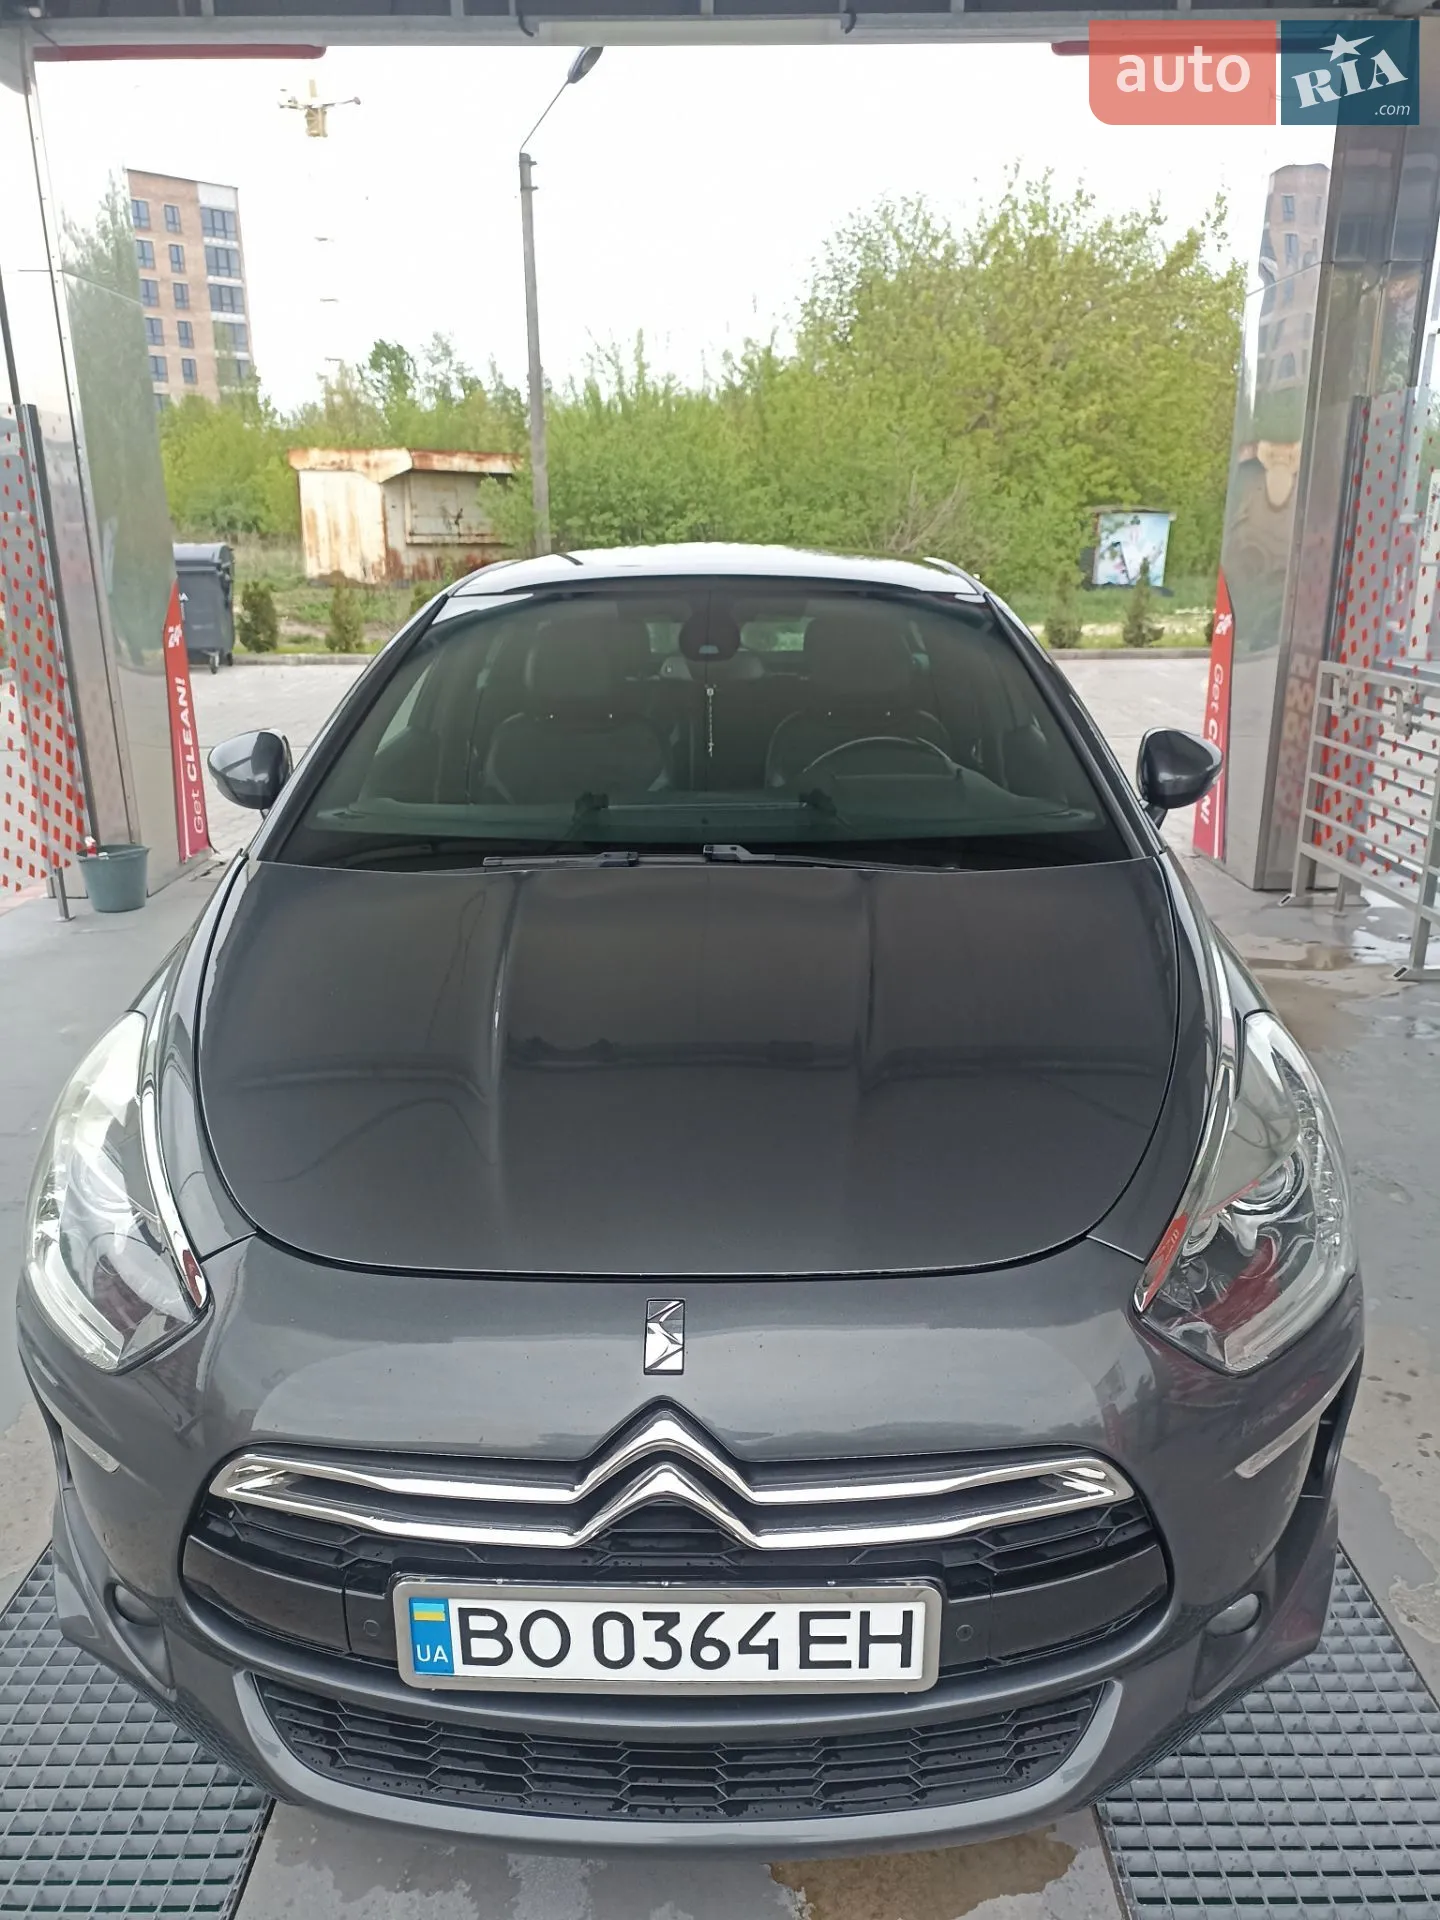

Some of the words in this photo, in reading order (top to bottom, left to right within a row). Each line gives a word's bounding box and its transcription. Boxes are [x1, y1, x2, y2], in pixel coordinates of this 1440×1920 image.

[175, 677, 197, 782] CLEAN!
[416, 1644, 449, 1663] UA
[457, 1606, 571, 1668] BO
[592, 1611, 779, 1670] 0364
[799, 1609, 913, 1670] EH
